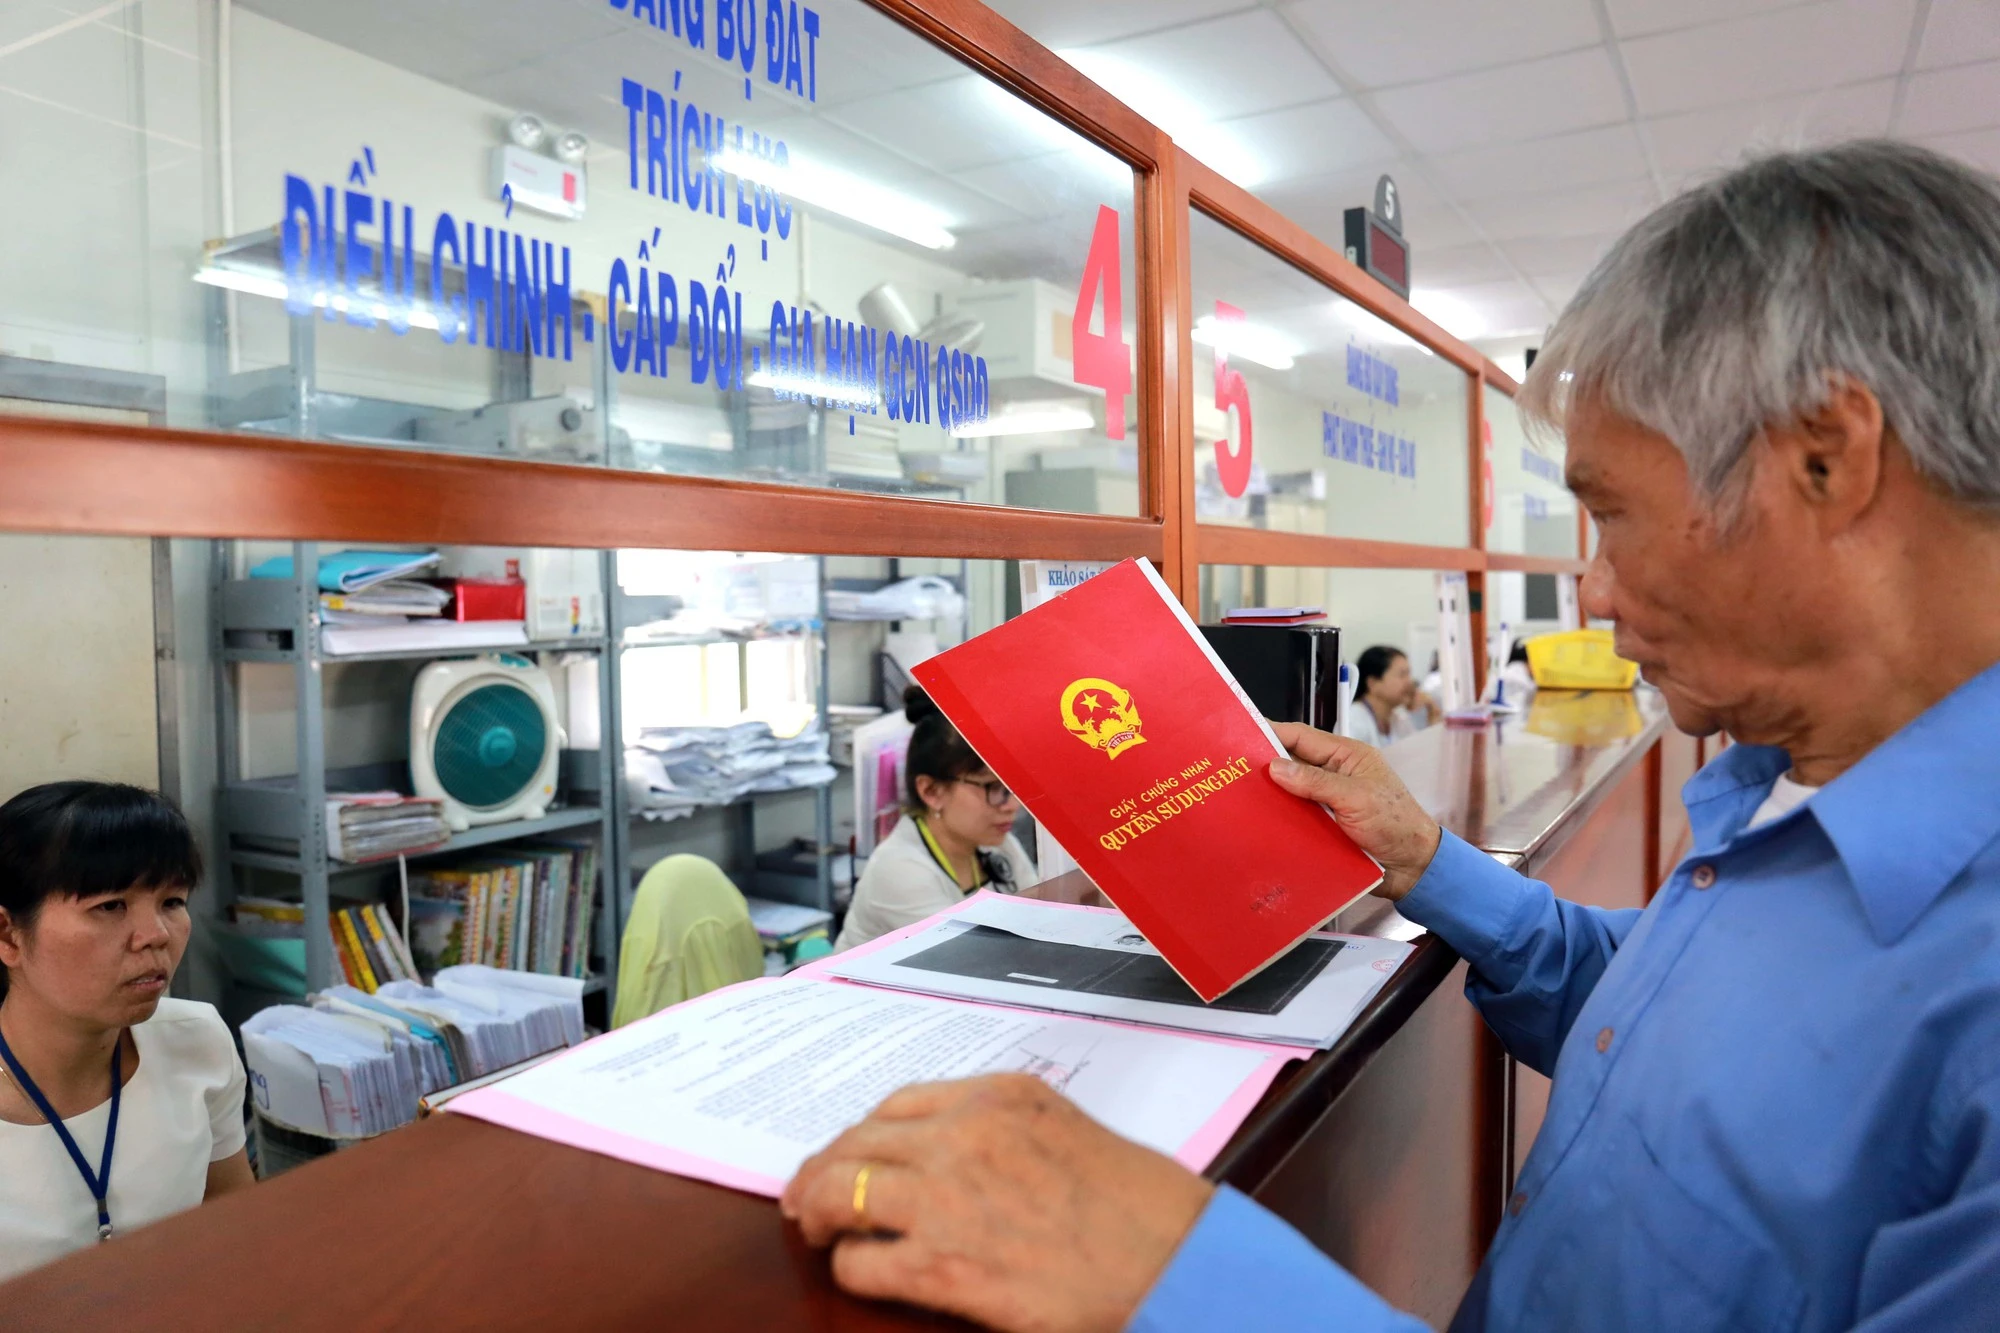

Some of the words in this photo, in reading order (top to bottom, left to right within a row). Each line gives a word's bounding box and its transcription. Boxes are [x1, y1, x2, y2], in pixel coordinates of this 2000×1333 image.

[622, 70, 726, 219] TRÍCH
[1385, 181, 1395, 220] 5
[282, 146, 415, 337] ĐIỀU
[430, 183, 572, 362] CHỈNH
[609, 227, 680, 378] CẤP
[689, 244, 743, 392] ĐỔI
[769, 300, 818, 405] GIA
[825, 315, 877, 435] HẠN
[884, 330, 930, 425] GCN
[1073, 204, 1132, 440] 4
[1215, 301, 1253, 498] 5
[1048, 564, 1076, 586] KHẢO
[1100, 810, 1161, 850] QUYỀN
[1156, 795, 1181, 820] SỬ
[1175, 775, 1224, 805] DỤNG
[1216, 756, 1252, 785] ĐẤT
[1110, 798, 1137, 818] GIẤY
[1140, 779, 1179, 802] CHỨNG
